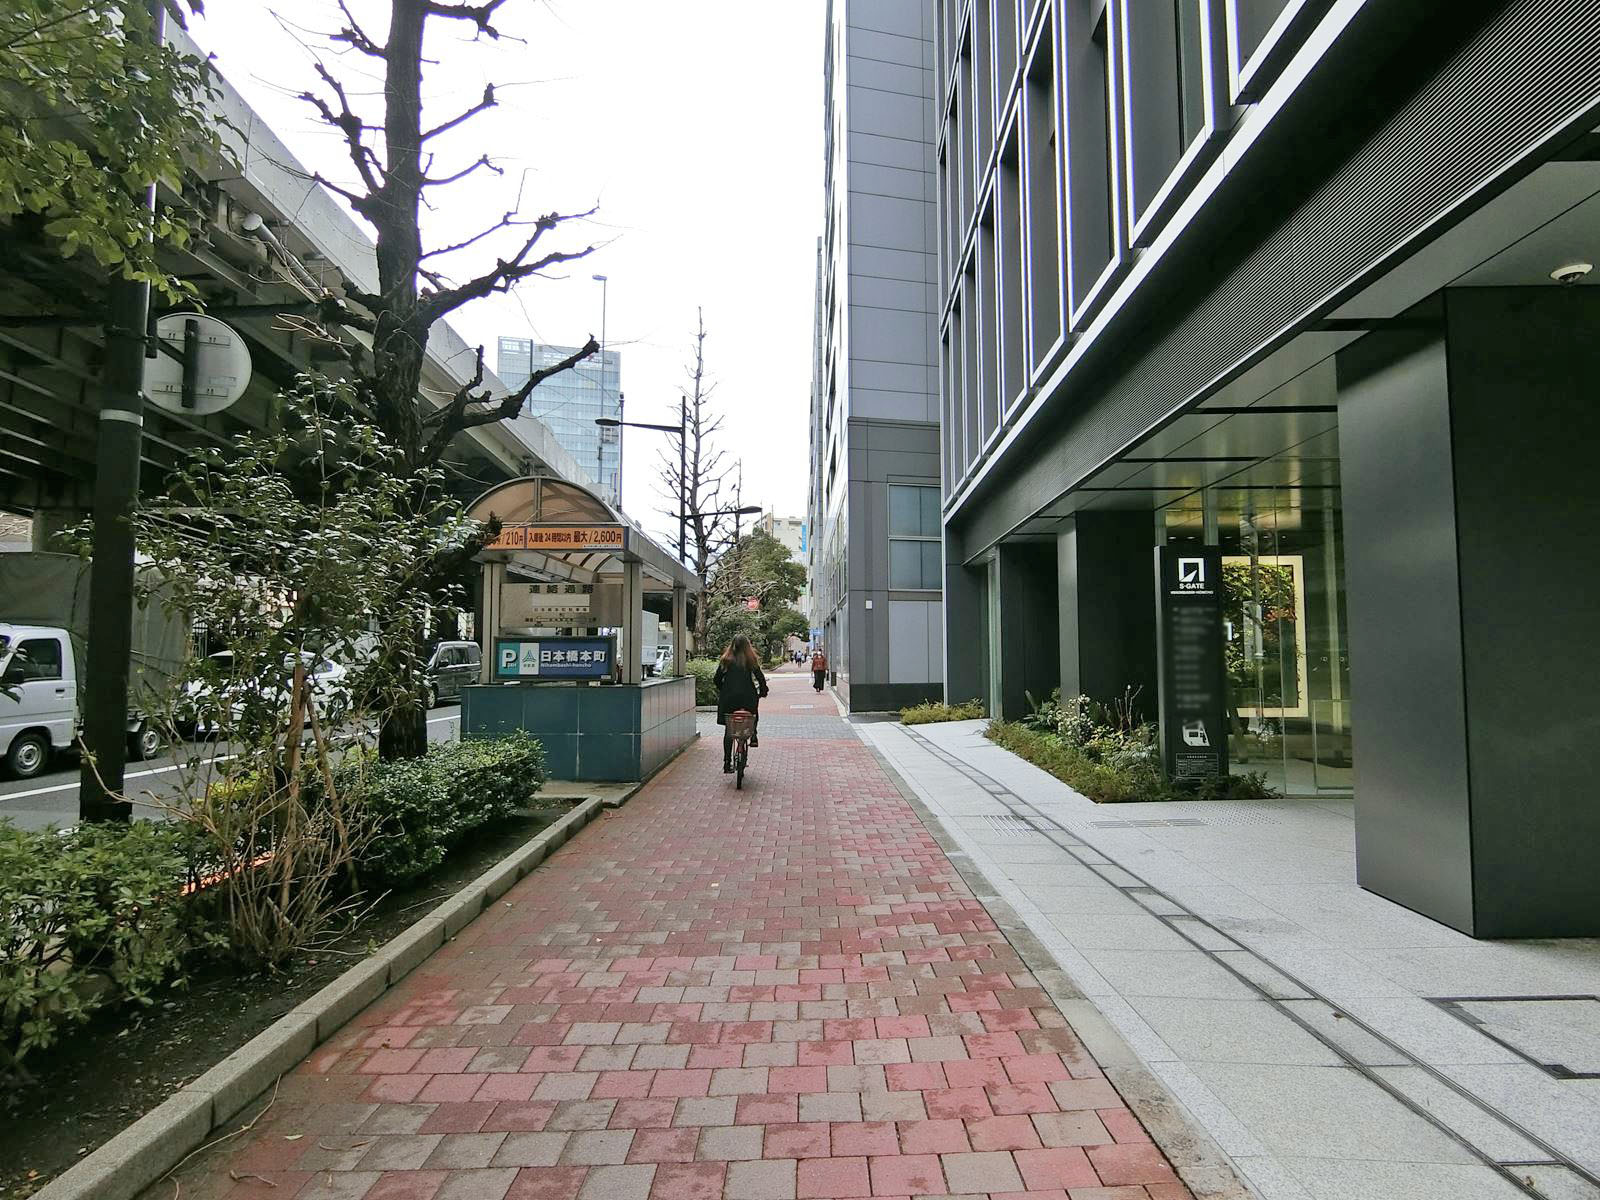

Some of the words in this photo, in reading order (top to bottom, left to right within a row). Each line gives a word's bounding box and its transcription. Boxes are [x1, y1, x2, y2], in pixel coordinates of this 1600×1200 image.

[502, 649, 517, 668] P
[541, 650, 606, 662] 日本橋本町
